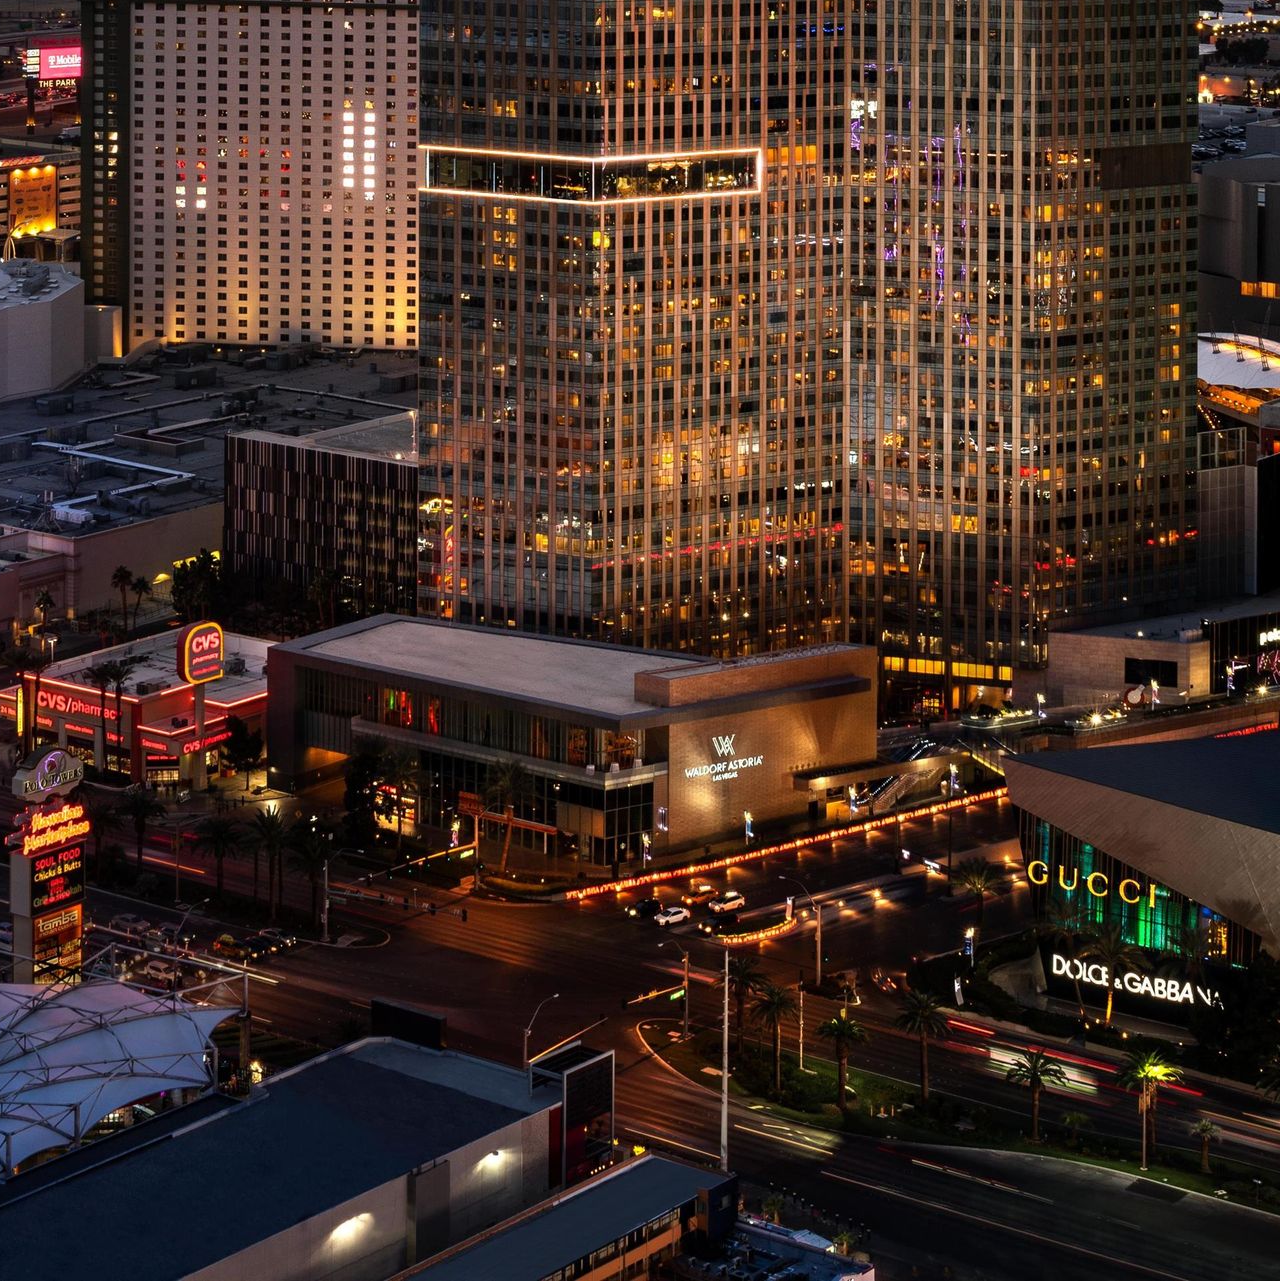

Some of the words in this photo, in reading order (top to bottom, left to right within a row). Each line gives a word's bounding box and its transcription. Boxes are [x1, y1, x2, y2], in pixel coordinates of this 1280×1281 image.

[39, 80, 54, 88] THE
[55, 78, 77, 87] PARK
[191, 631, 220, 653] CVS
[685, 762, 728, 779] WALDORF
[728, 756, 763, 771] ASTORIA
[712, 774, 722, 782] LAS
[722, 771, 739, 781] VEGAS
[31, 804, 84, 834] Hawaiian
[23, 820, 90, 856] Marketplace
[35, 856, 56, 871] SOUL
[58, 847, 81, 863] FOOD
[34, 869, 56, 882] Chicks
[57, 865, 63, 875] &
[64, 860, 81, 872] Butts
[1028, 860, 1156, 908] GUCCI
[38, 910, 78, 932] tamba
[1052, 954, 1109, 987] DOLCE
[1114, 978, 1123, 989] &
